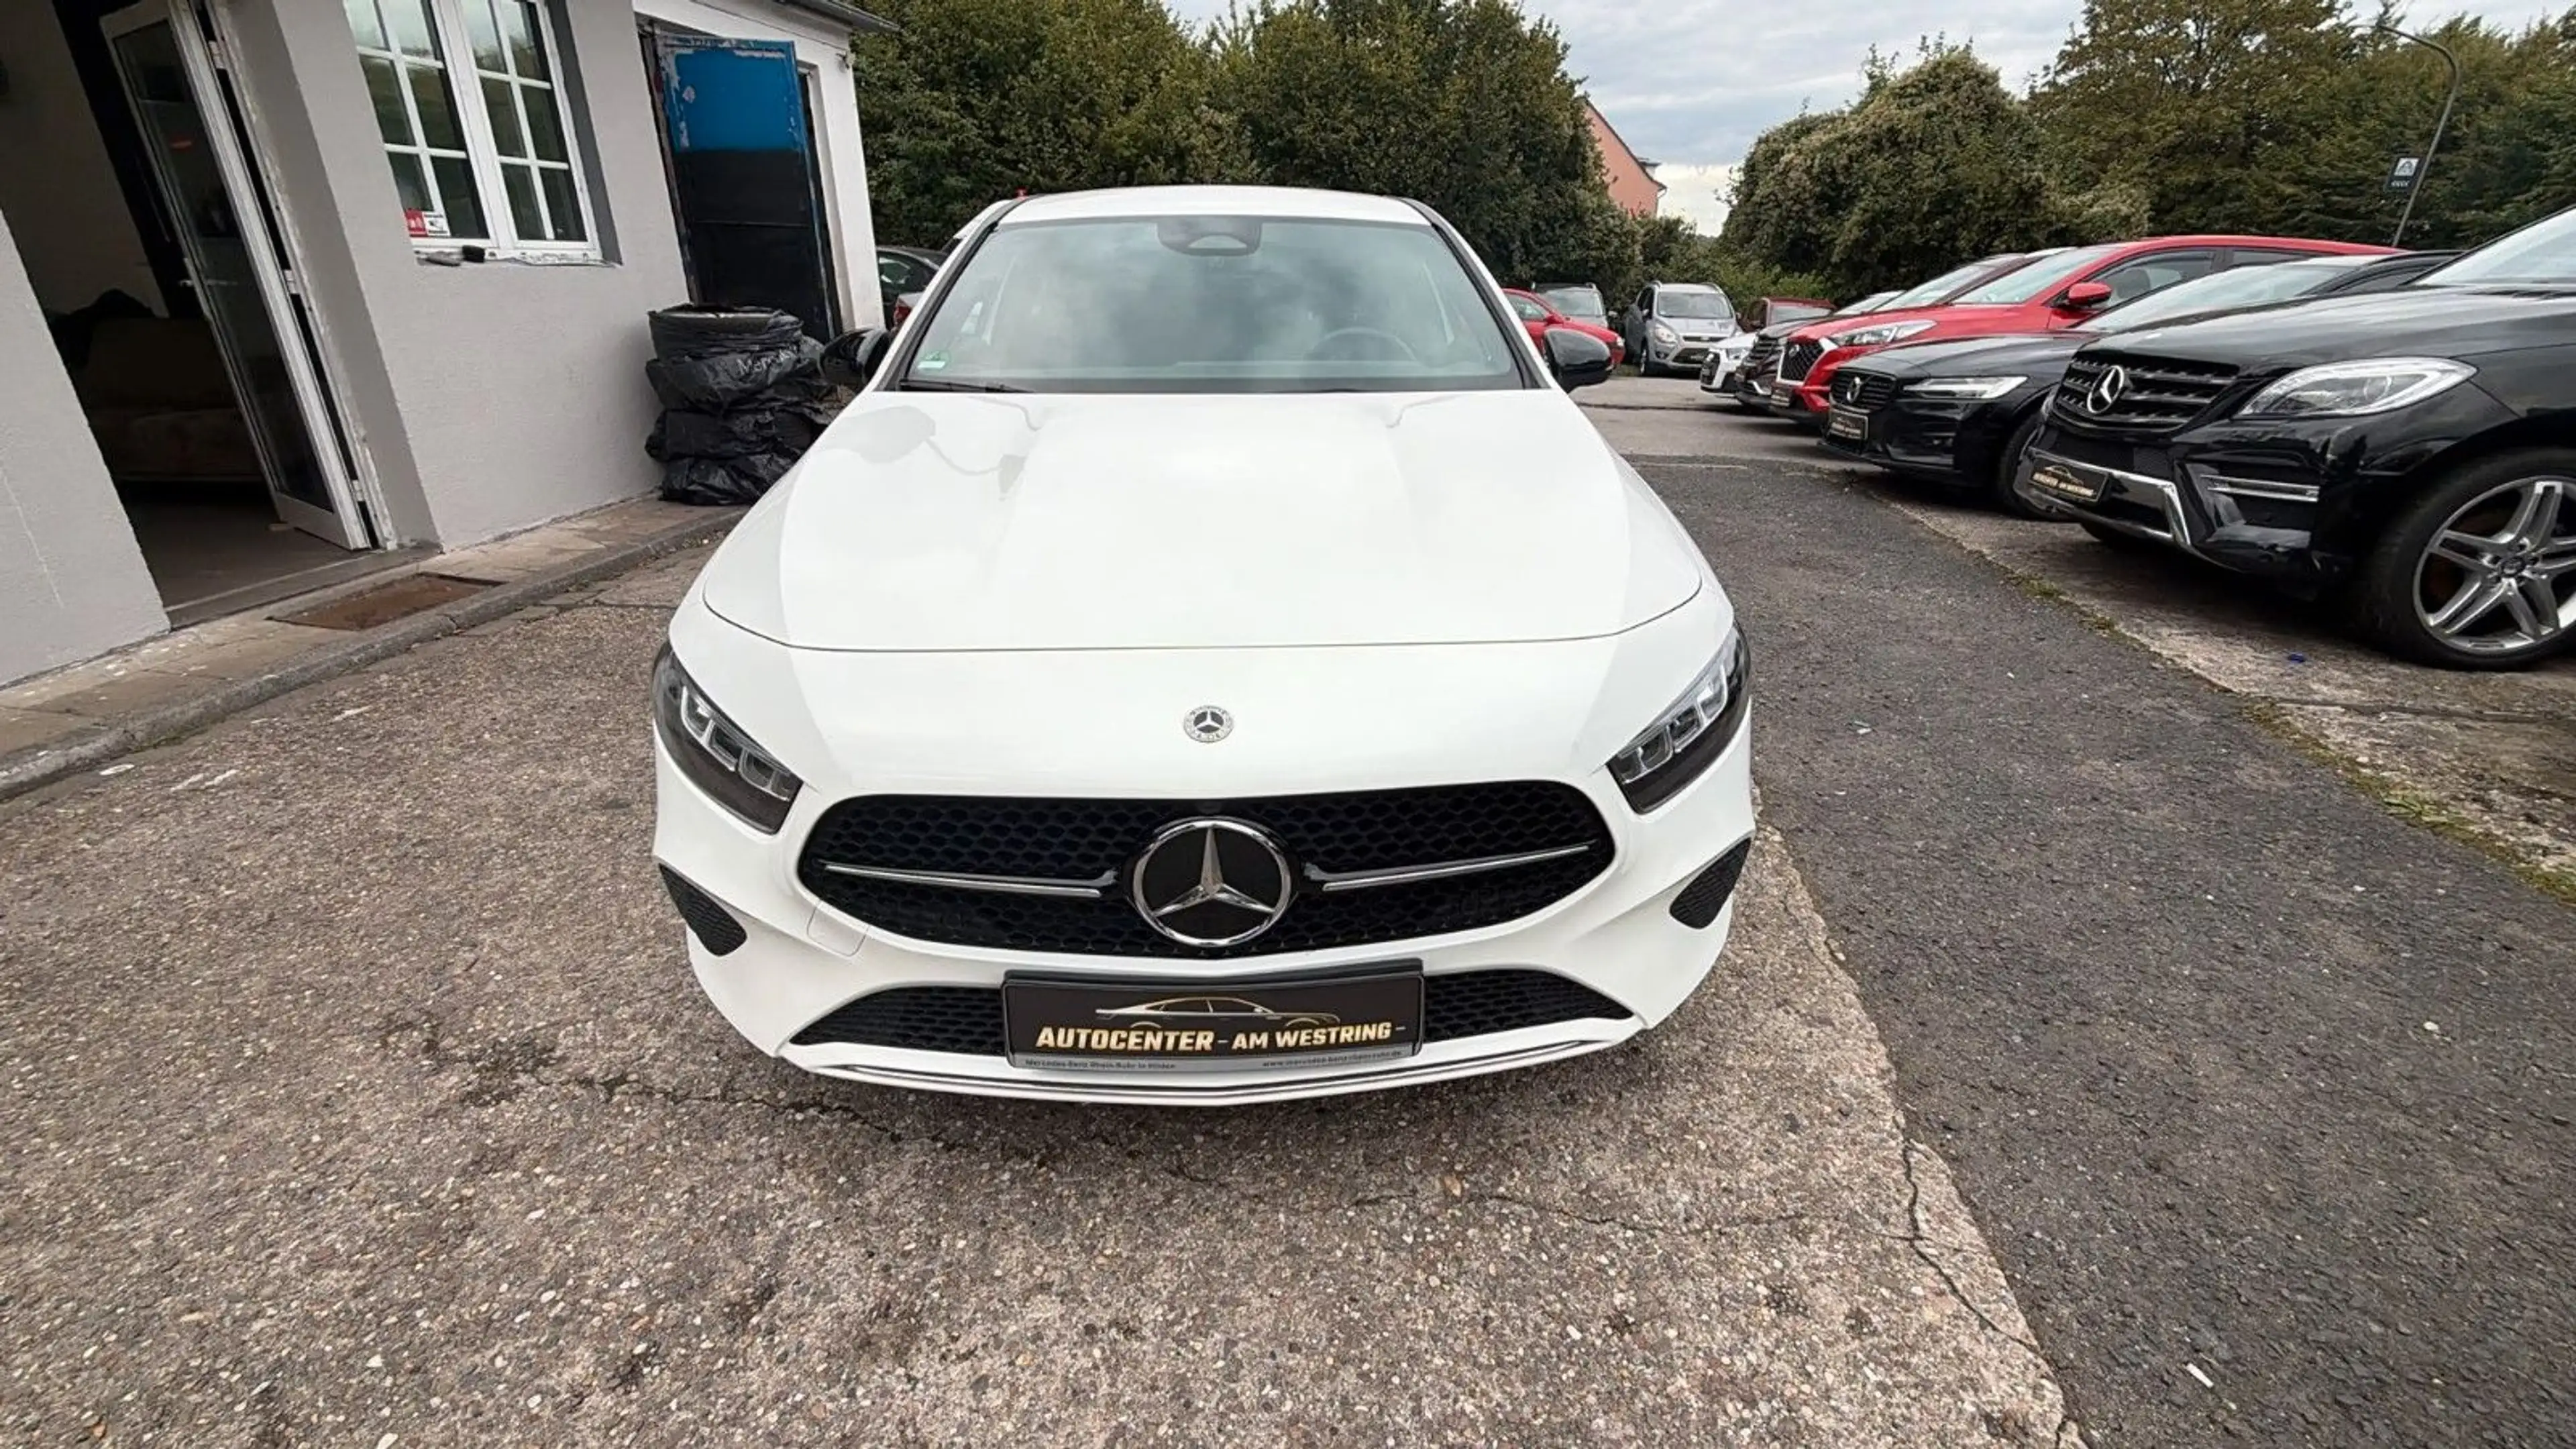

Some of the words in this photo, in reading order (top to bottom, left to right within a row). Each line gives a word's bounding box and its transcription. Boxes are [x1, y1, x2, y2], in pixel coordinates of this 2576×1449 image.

[1035, 1026, 1216, 1051] AUTOCENTER
[1231, 1031, 1269, 1050] AM
[1275, 1021, 1393, 1048] WESTRING
